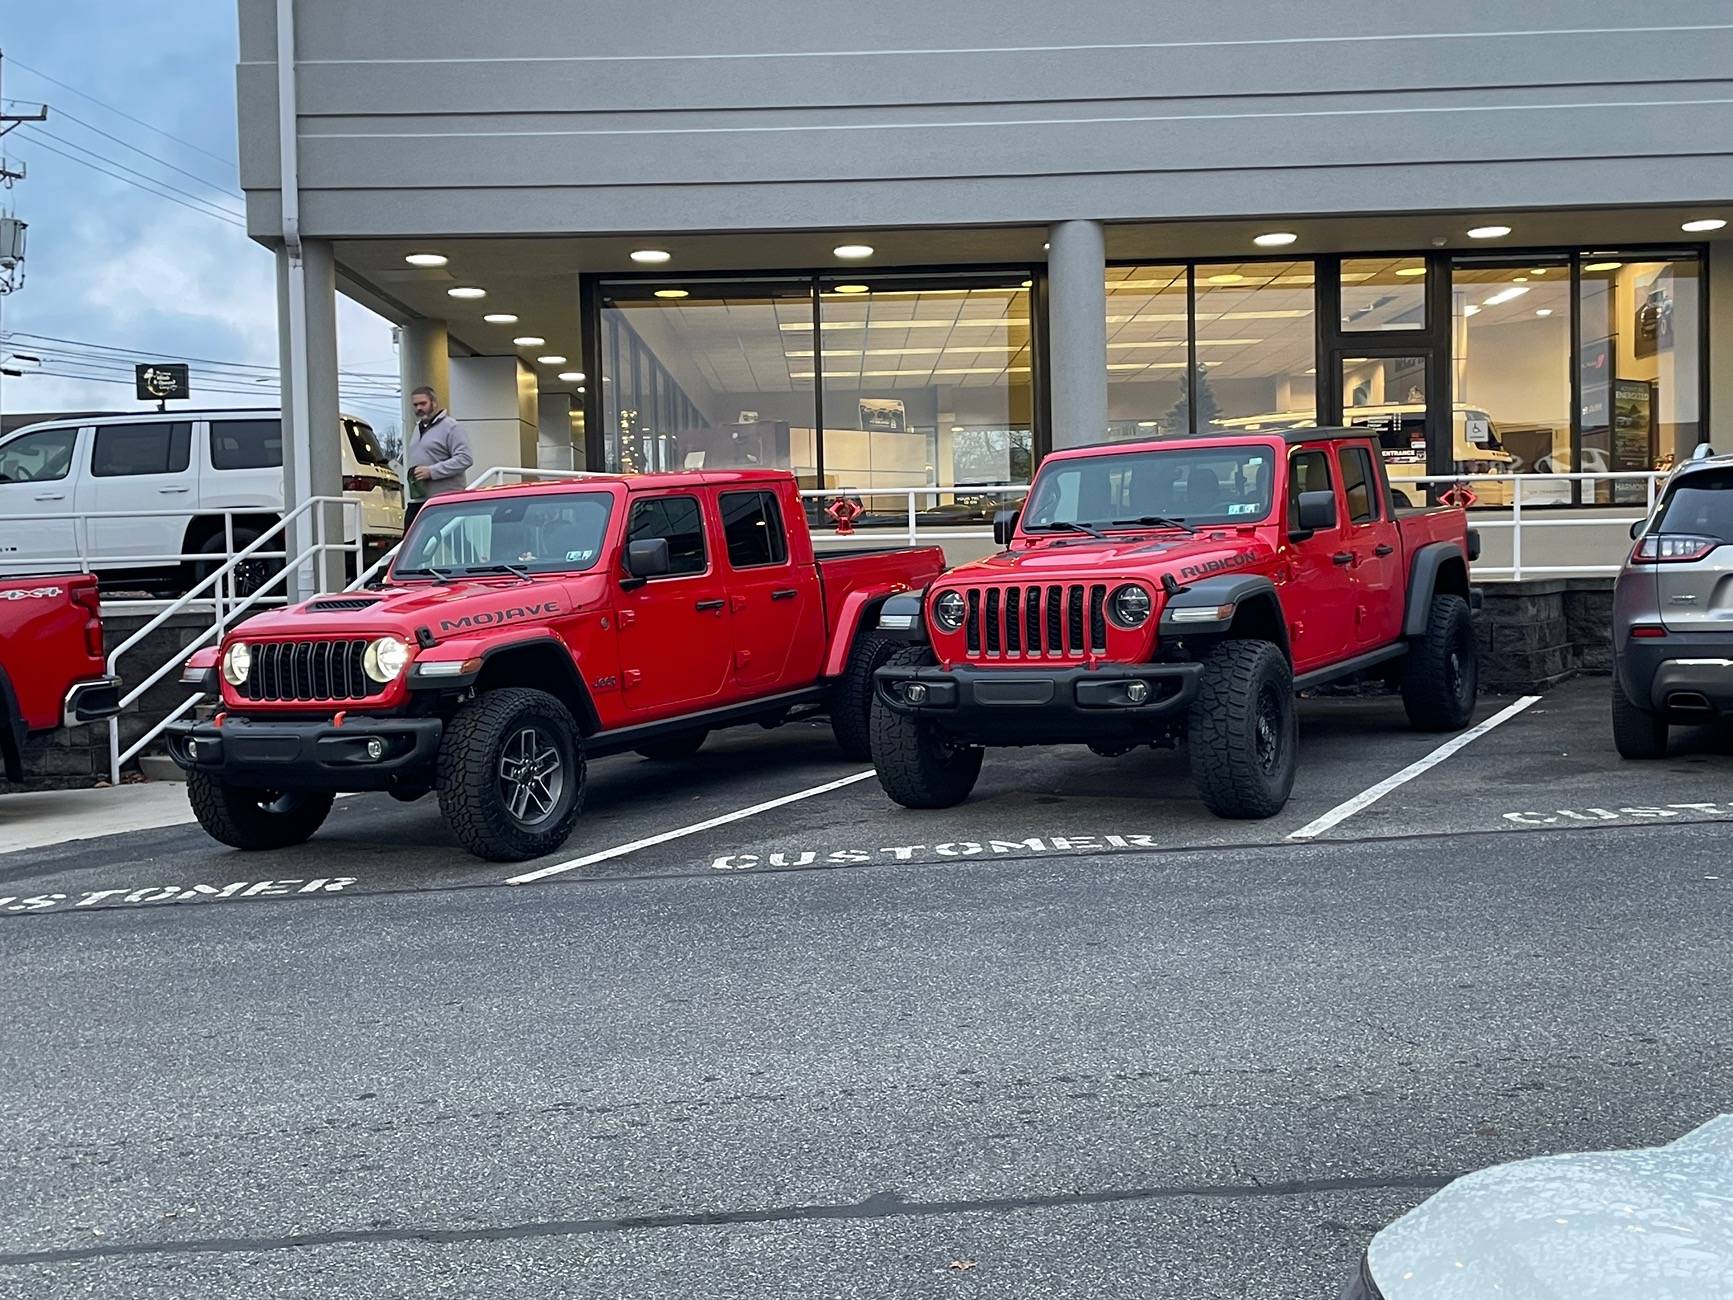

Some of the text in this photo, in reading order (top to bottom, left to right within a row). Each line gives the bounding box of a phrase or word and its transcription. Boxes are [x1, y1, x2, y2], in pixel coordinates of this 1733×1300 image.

[1381, 449, 1416, 458] ENTRANCE
[1181, 552, 1256, 578] RUBICON
[440, 601, 560, 631] MOJAVE
[1502, 802, 1733, 824] CUST
[710, 834, 1160, 870] CUSTOMER
[0, 877, 358, 911] STOMER
